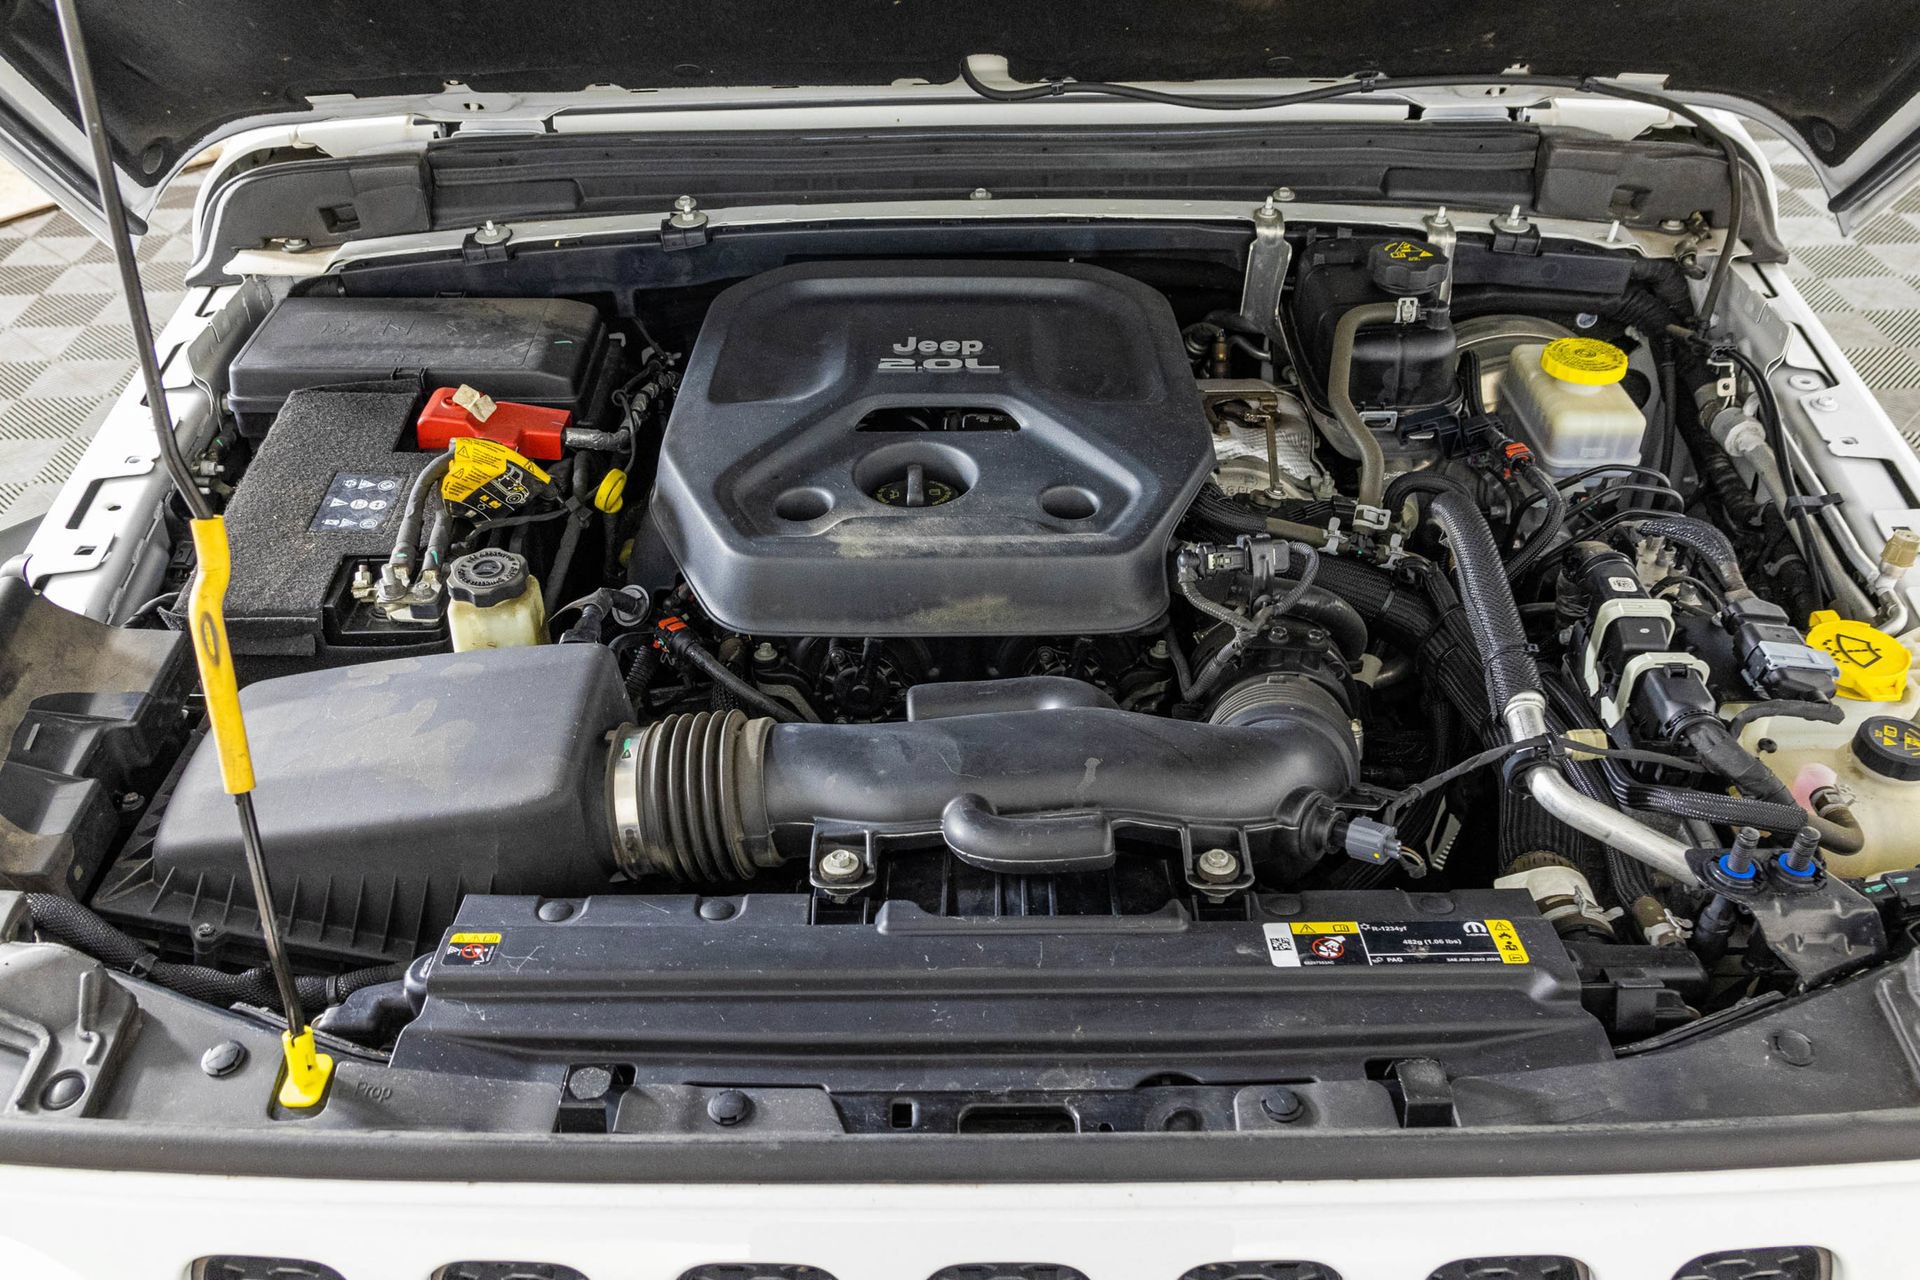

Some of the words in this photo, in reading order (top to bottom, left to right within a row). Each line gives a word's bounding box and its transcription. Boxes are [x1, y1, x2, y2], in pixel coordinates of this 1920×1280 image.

[893, 336, 984, 355] Jeep
[878, 358, 1000, 373] 2.0L
[355, 1081, 393, 1102] Prop
